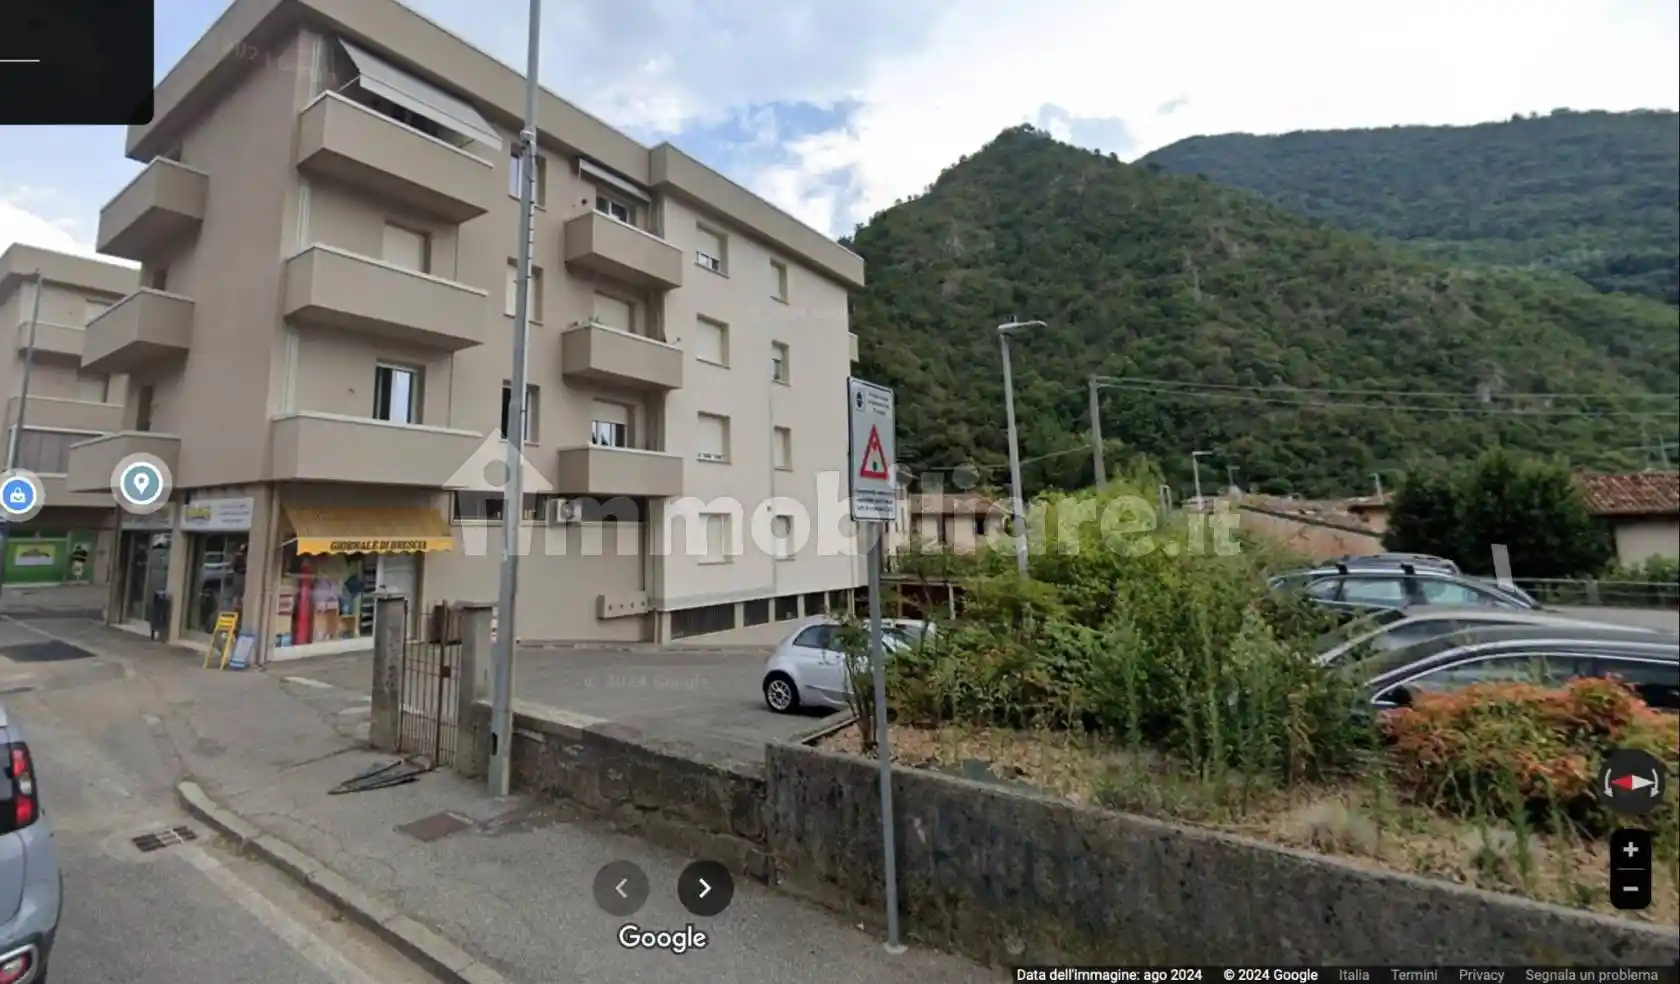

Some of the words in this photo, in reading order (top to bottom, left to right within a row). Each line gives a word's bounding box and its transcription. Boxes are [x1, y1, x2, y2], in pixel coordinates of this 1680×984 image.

[329, 539, 377, 551] GIORNALE
[379, 539, 388, 551] DI
[390, 539, 428, 551] BRESCIA
